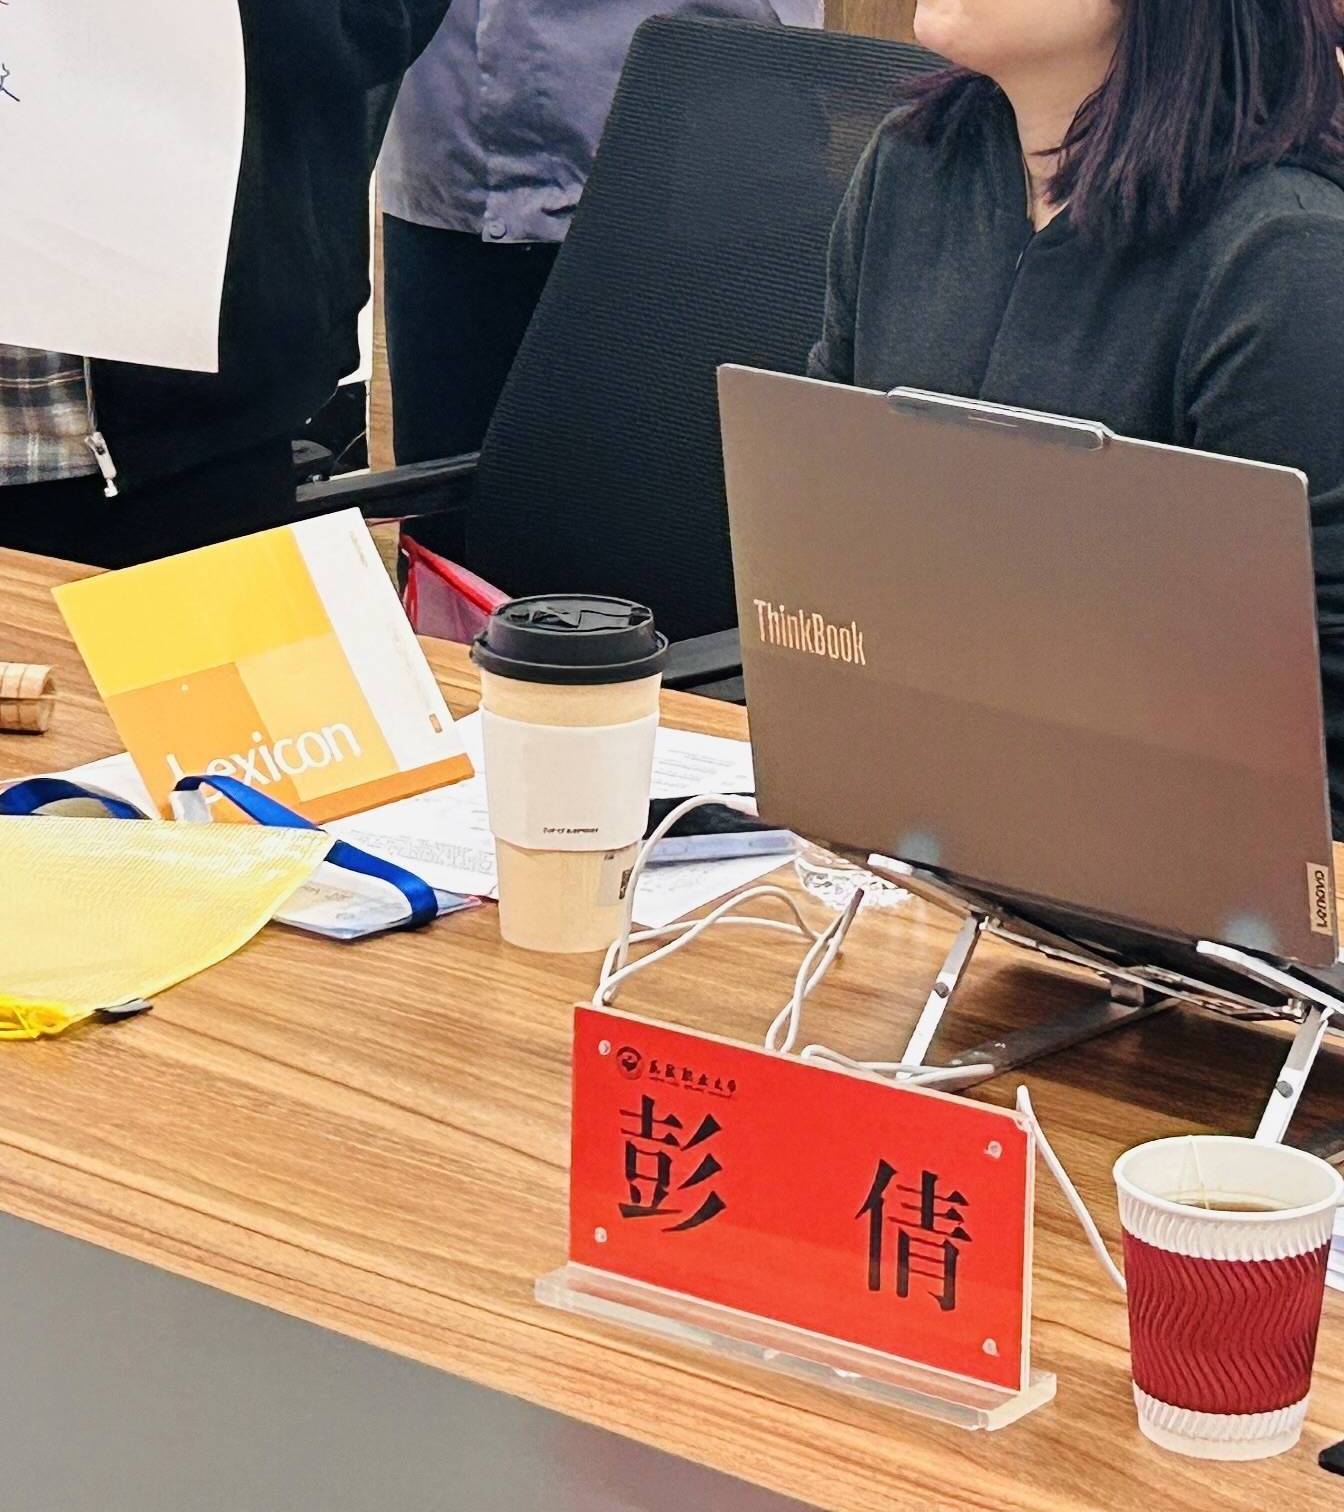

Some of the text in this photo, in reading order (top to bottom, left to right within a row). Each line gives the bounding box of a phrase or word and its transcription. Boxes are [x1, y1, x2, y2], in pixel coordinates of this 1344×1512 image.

[753, 598, 867, 666] ThinkBook
[166, 722, 361, 805] Lexicon
[618, 1094, 973, 1312] 彭 倩
